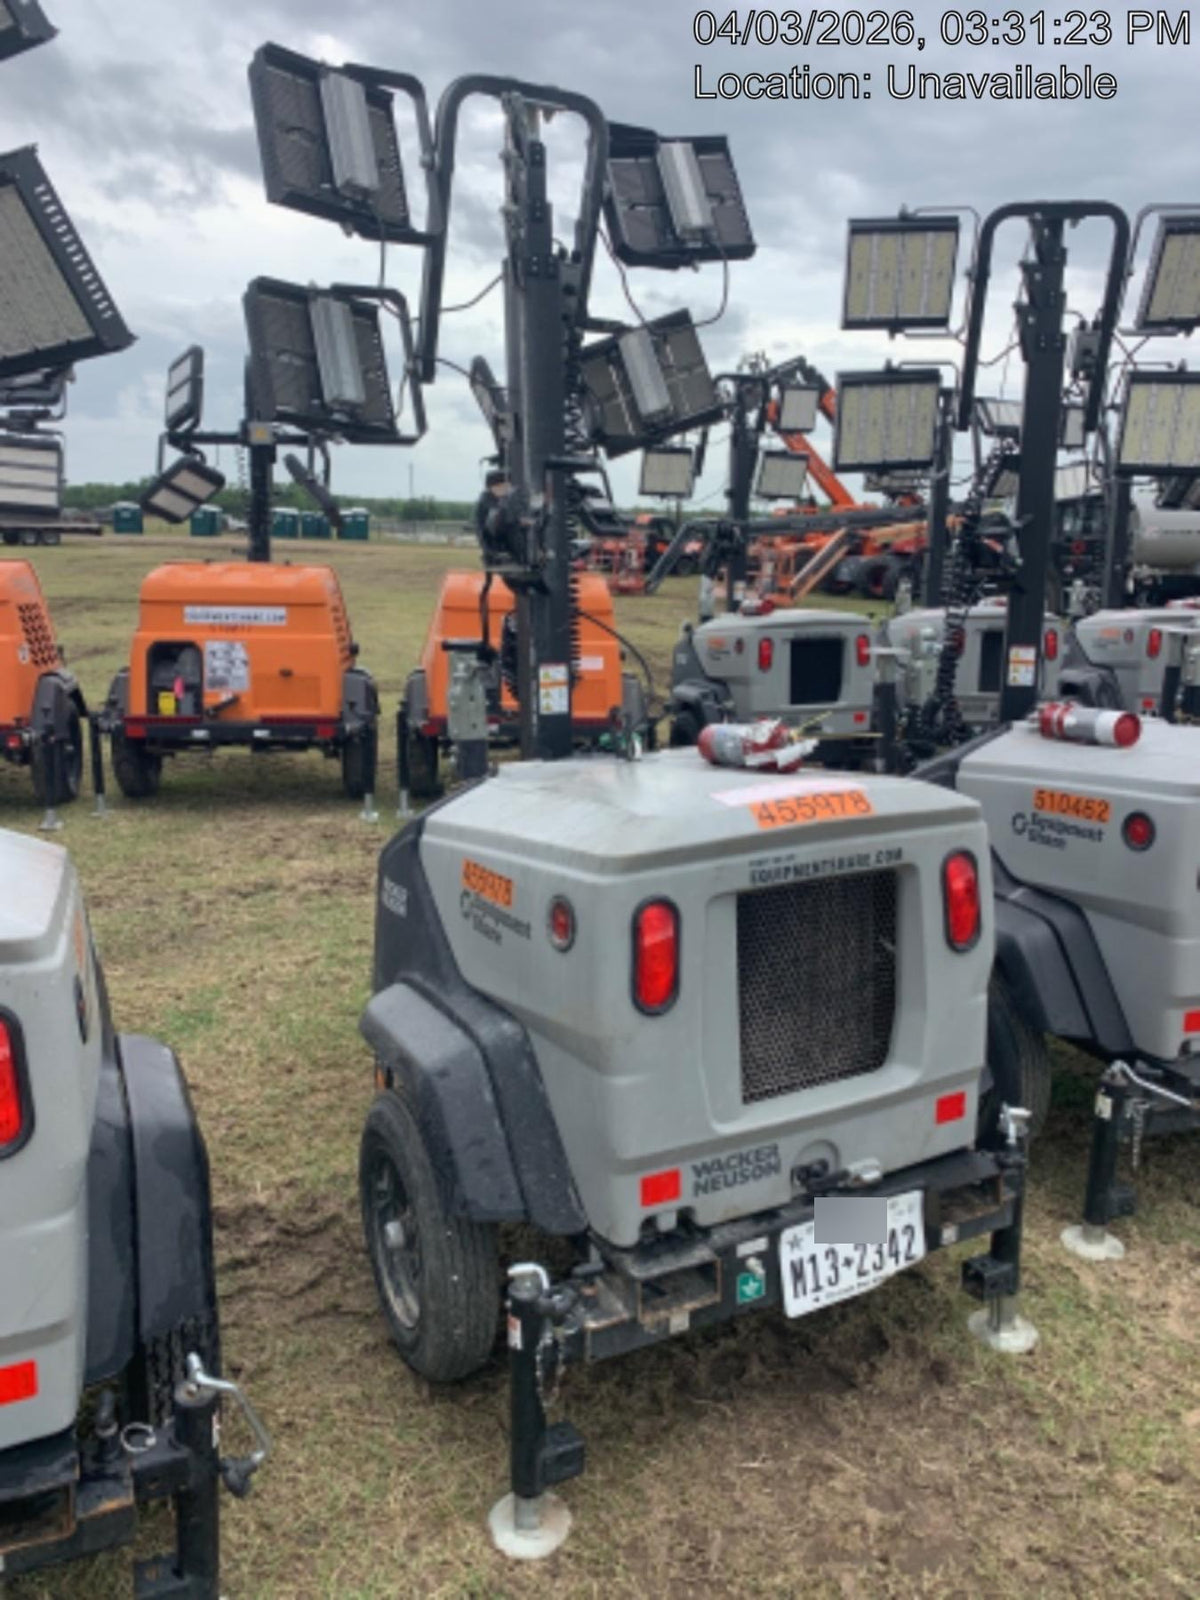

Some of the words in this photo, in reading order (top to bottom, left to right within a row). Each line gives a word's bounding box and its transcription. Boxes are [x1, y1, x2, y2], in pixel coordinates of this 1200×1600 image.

[756, 791, 872, 823] 455978
[691, 1143, 779, 1178] WACKER
[693, 1159, 782, 1197] NEUSON
